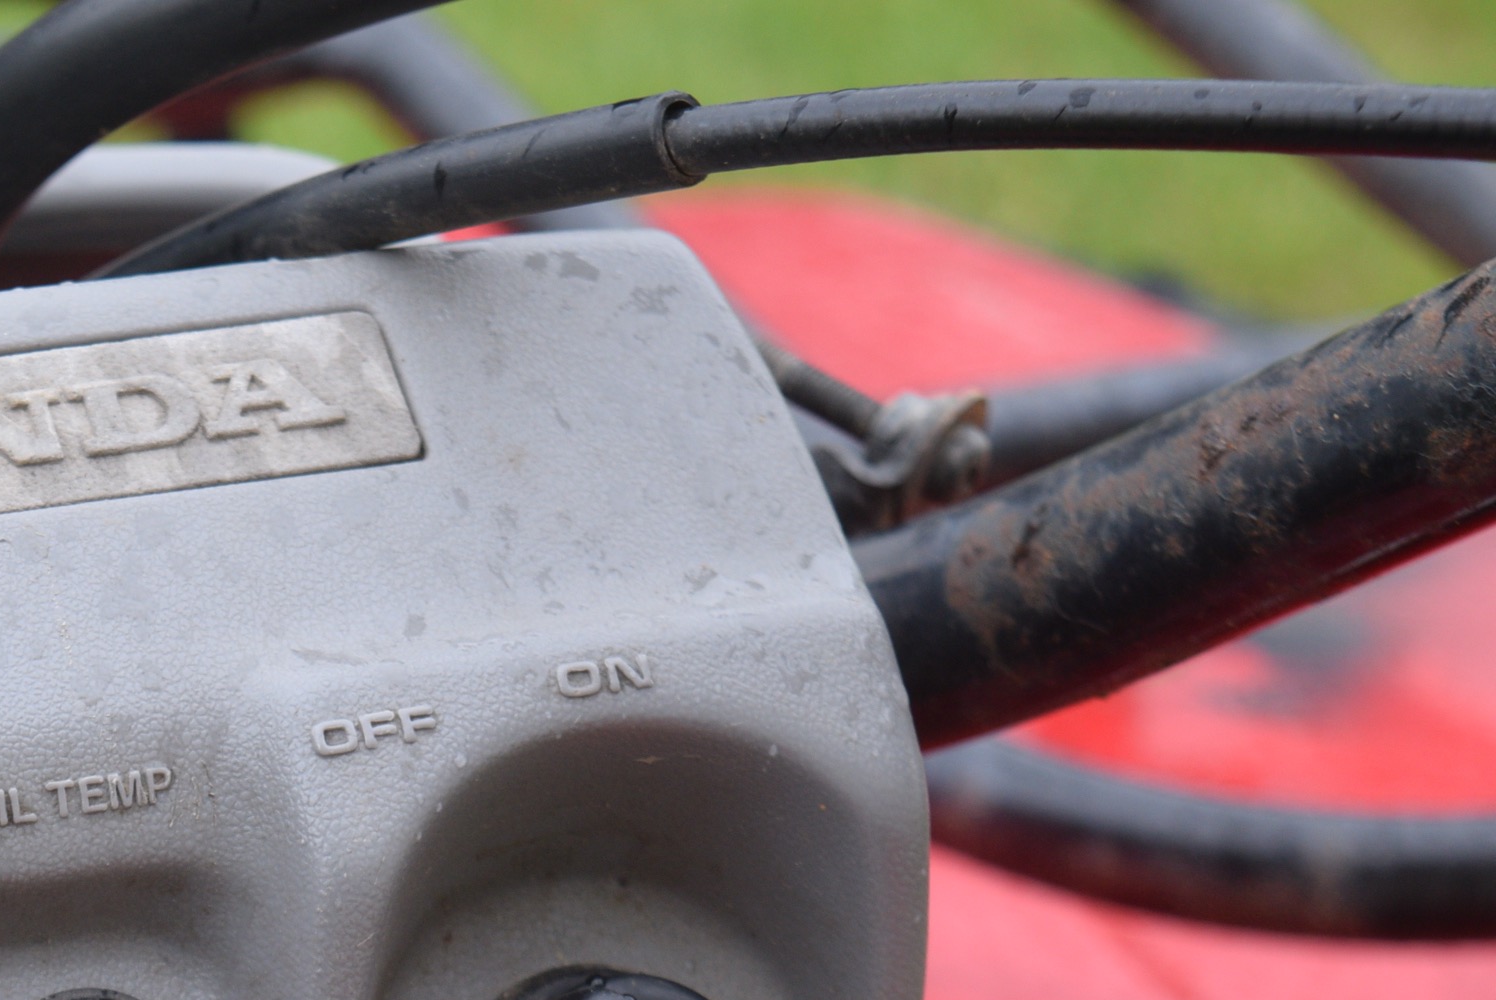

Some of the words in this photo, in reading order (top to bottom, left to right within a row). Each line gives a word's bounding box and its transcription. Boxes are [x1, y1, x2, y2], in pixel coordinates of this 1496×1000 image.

[556, 653, 655, 698] ON
[310, 704, 437, 757] OFF
[45, 767, 174, 819] TEMP
